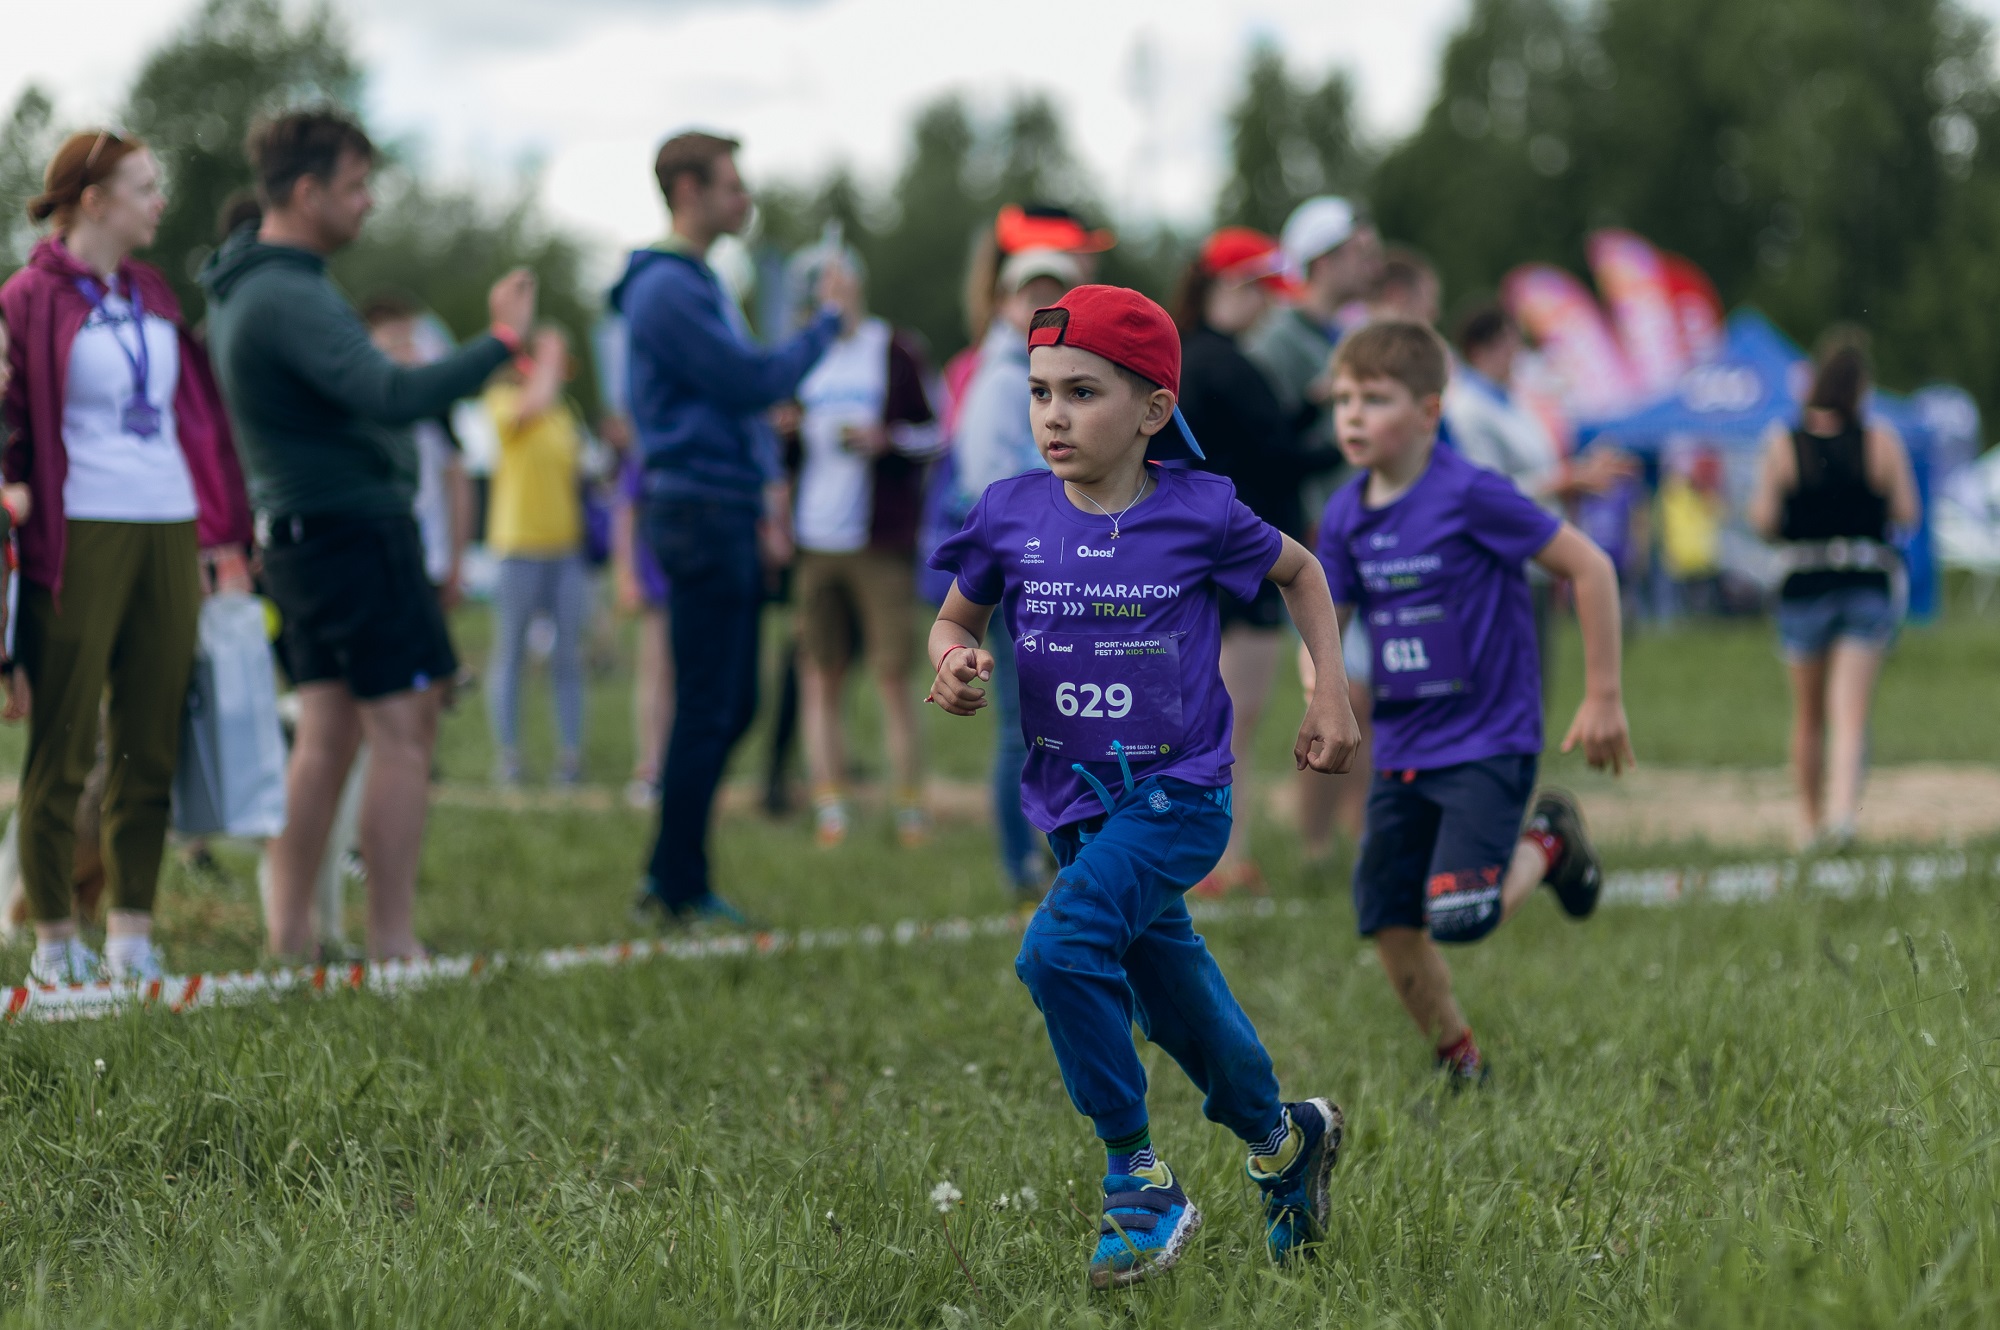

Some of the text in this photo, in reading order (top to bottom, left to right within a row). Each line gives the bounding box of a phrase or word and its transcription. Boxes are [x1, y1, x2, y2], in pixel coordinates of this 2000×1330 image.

[1026, 599, 1147, 618] FEST TRAIL
[1125, 648, 1144, 656] KIDS
[1383, 637, 1431, 673] 611
[1055, 681, 1133, 719] 629
